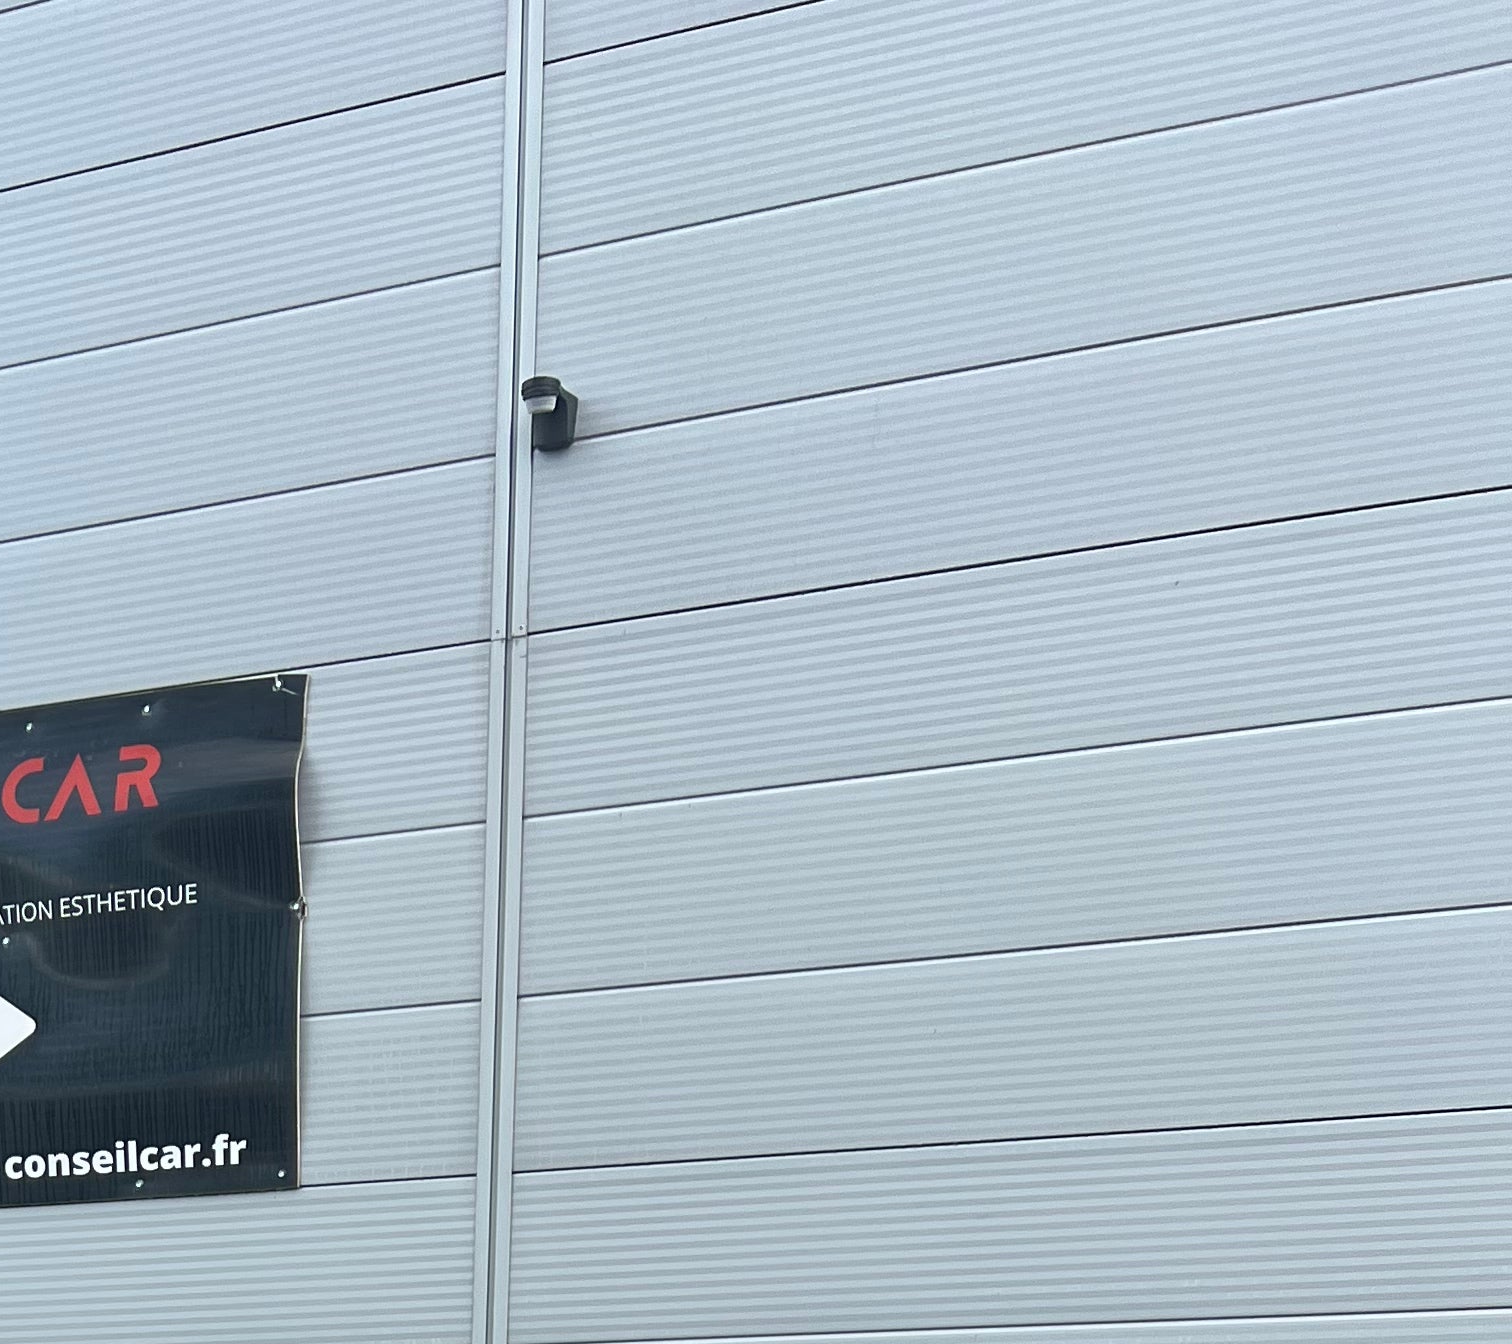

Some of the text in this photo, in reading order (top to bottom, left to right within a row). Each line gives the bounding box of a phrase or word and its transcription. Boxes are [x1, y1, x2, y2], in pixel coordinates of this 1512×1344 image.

[1, 744, 161, 824] CAR
[59, 883, 198, 918] ESTHETIQUE
[4, 1133, 247, 1180] conseilcar.fr
